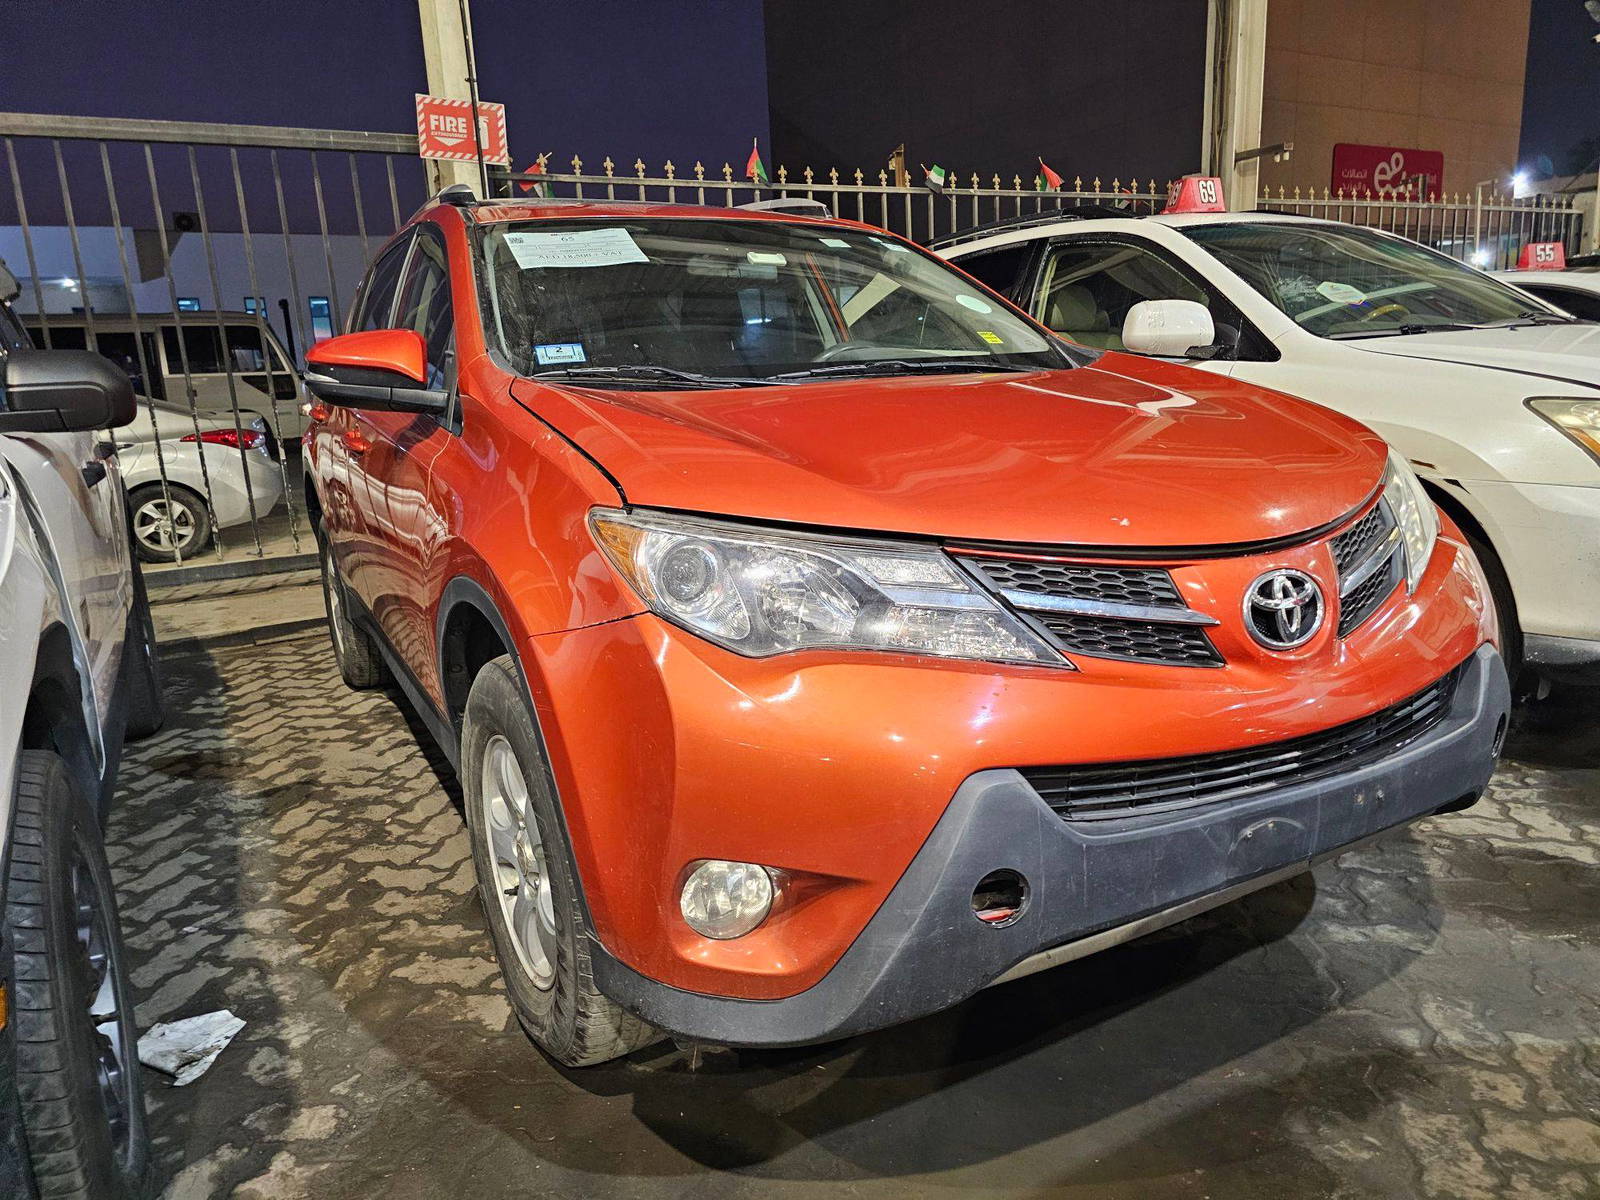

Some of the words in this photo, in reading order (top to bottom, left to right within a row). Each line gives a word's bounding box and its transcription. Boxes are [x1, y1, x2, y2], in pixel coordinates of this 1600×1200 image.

[430, 115, 467, 133] FIRE
[1199, 180, 1217, 203] 69
[1536, 244, 1554, 262] 55
